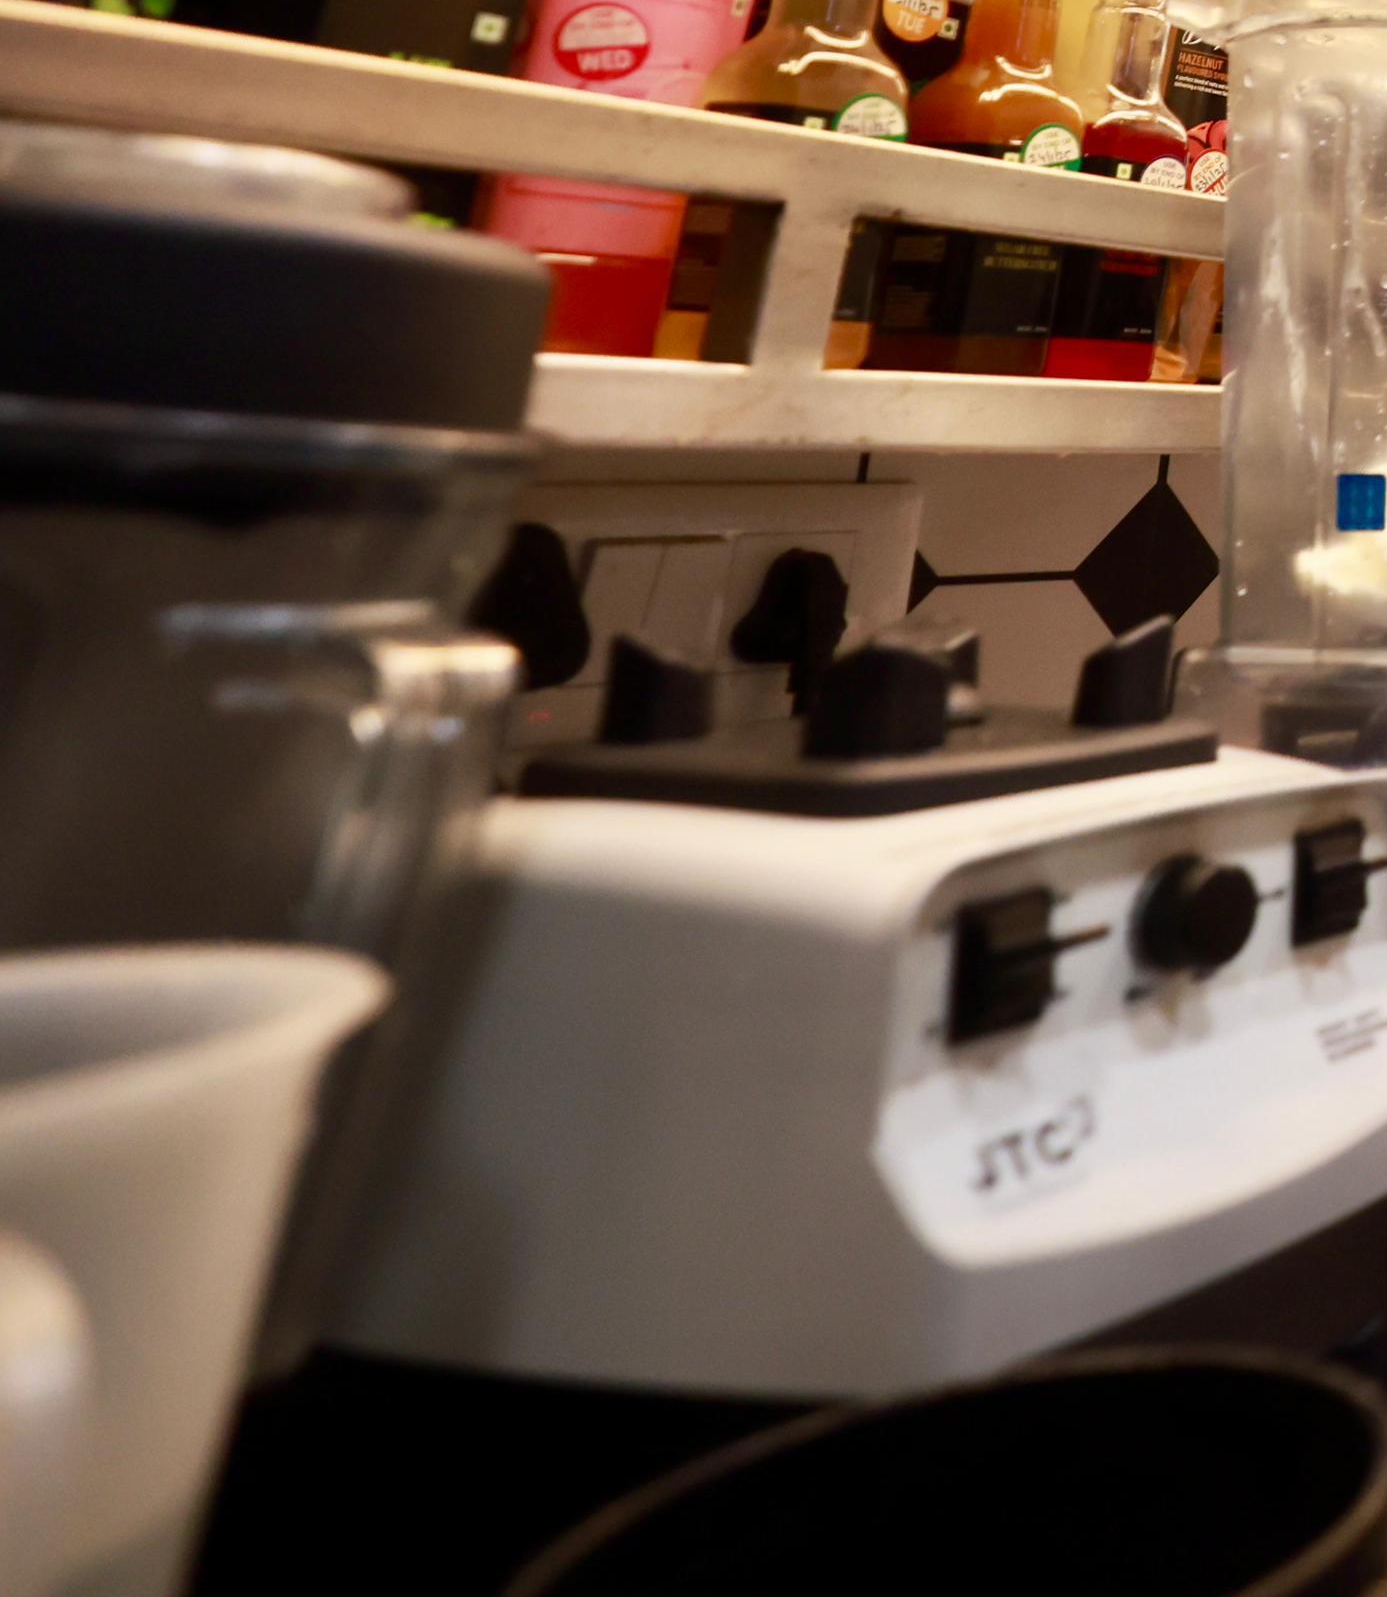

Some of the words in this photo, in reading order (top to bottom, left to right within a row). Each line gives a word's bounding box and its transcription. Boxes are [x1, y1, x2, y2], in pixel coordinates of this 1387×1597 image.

[897, 10, 926, 36] TUE
[576, 49, 633, 73] WED
[1178, 51, 1225, 70] HAZELNUT
[977, 1120, 1073, 1192] JTC
